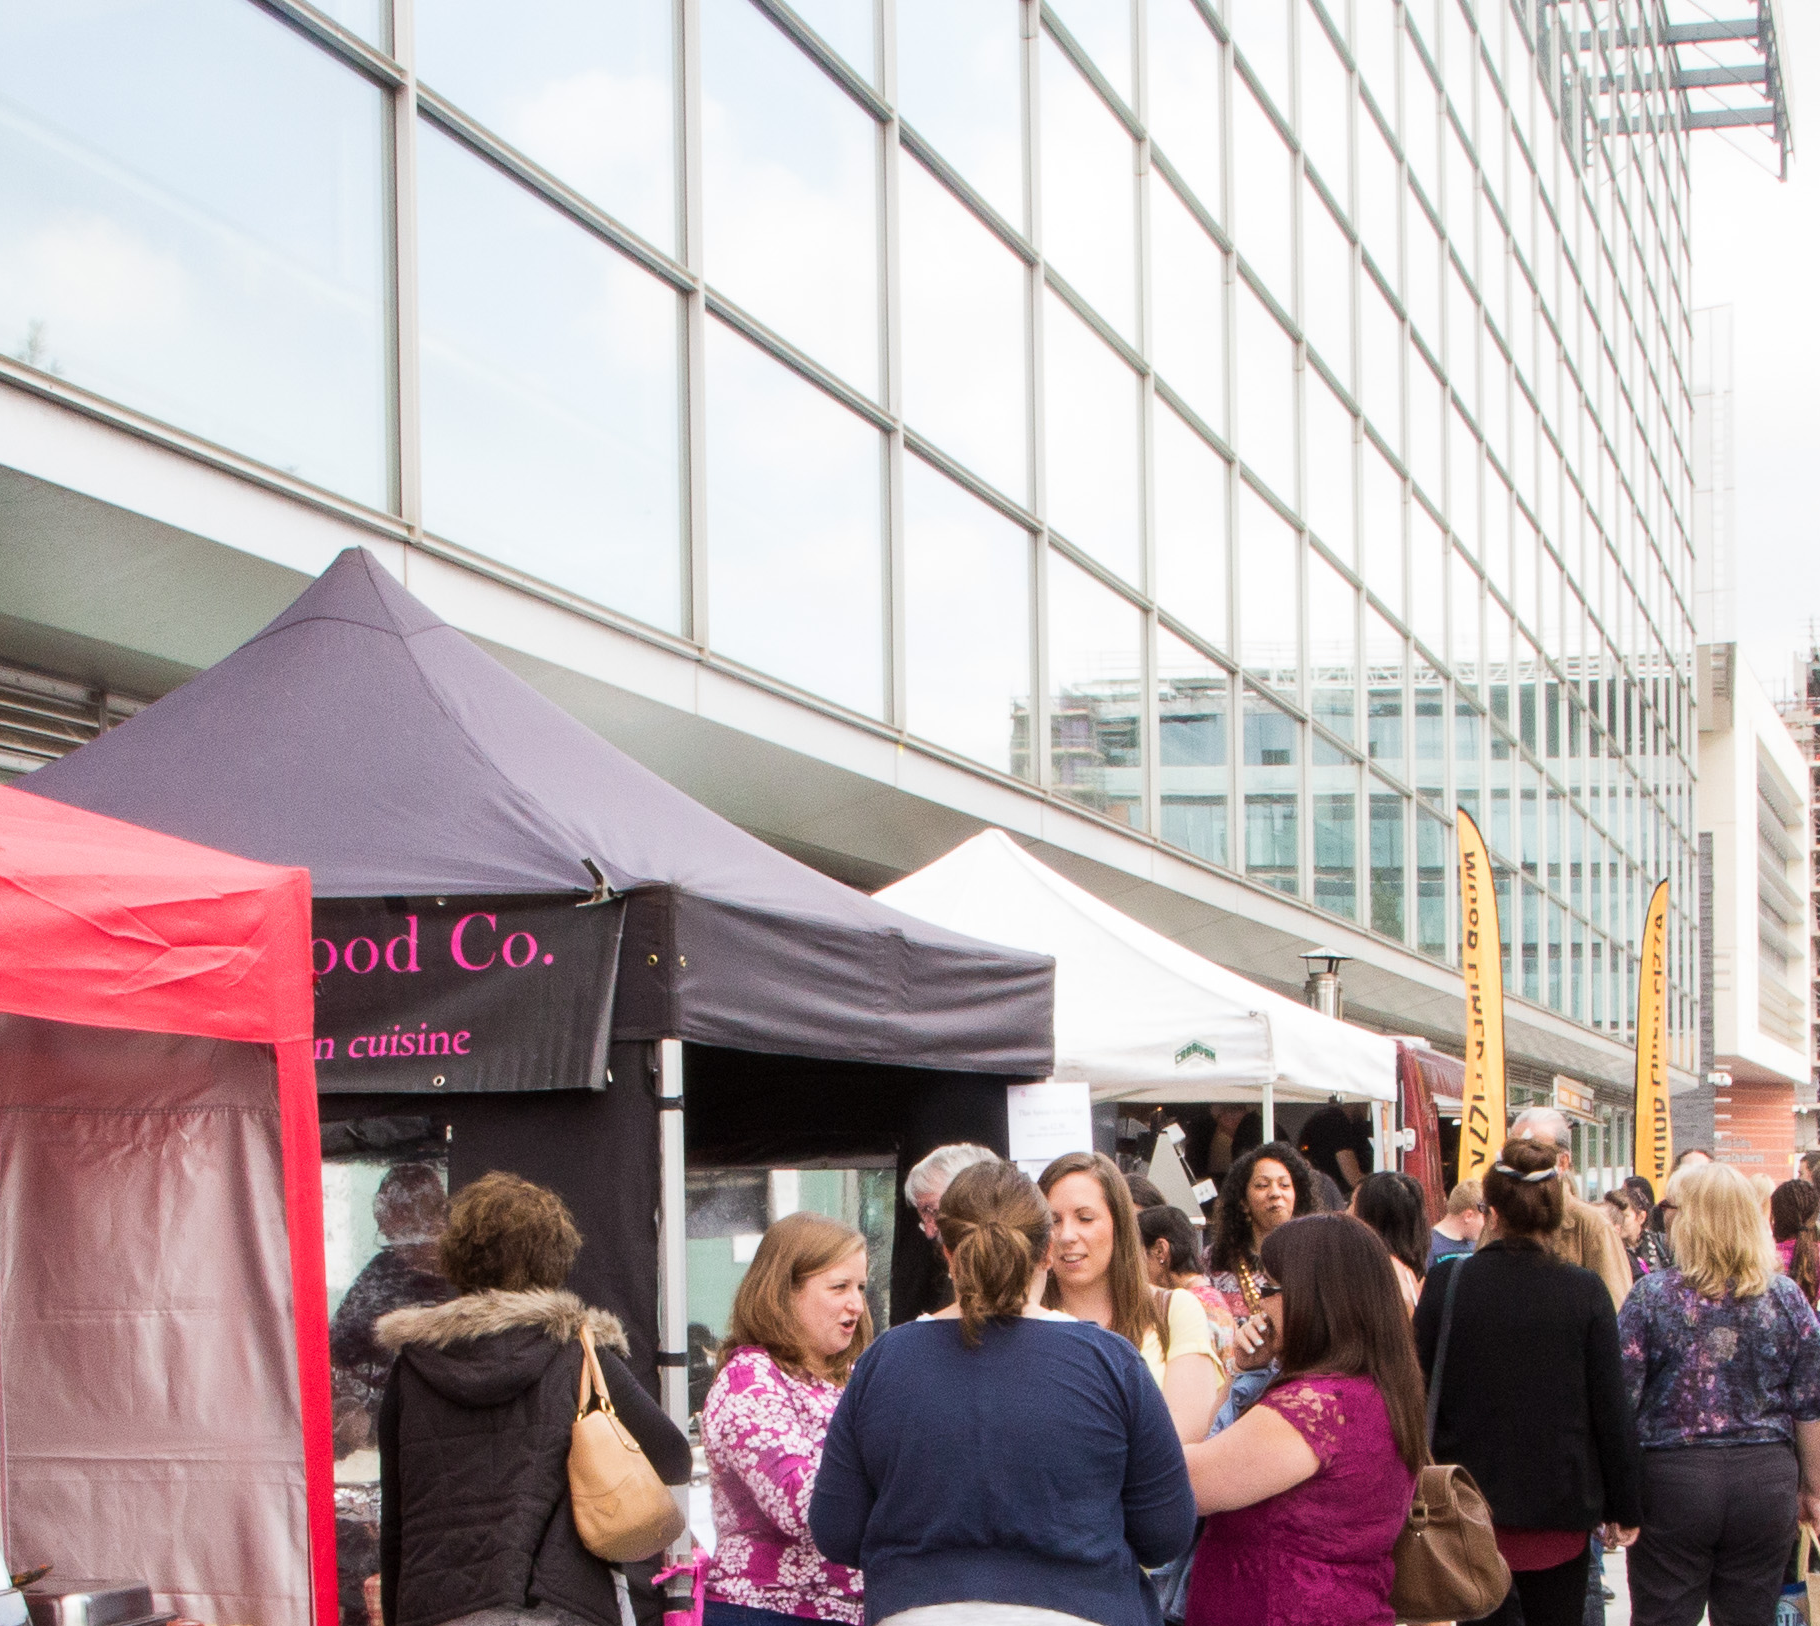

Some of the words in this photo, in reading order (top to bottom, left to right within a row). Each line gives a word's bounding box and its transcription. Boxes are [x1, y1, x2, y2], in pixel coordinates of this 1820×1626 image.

[312, 914, 422, 976] ood
[450, 911, 554, 972] Co.
[347, 1022, 472, 1060] cuisine
